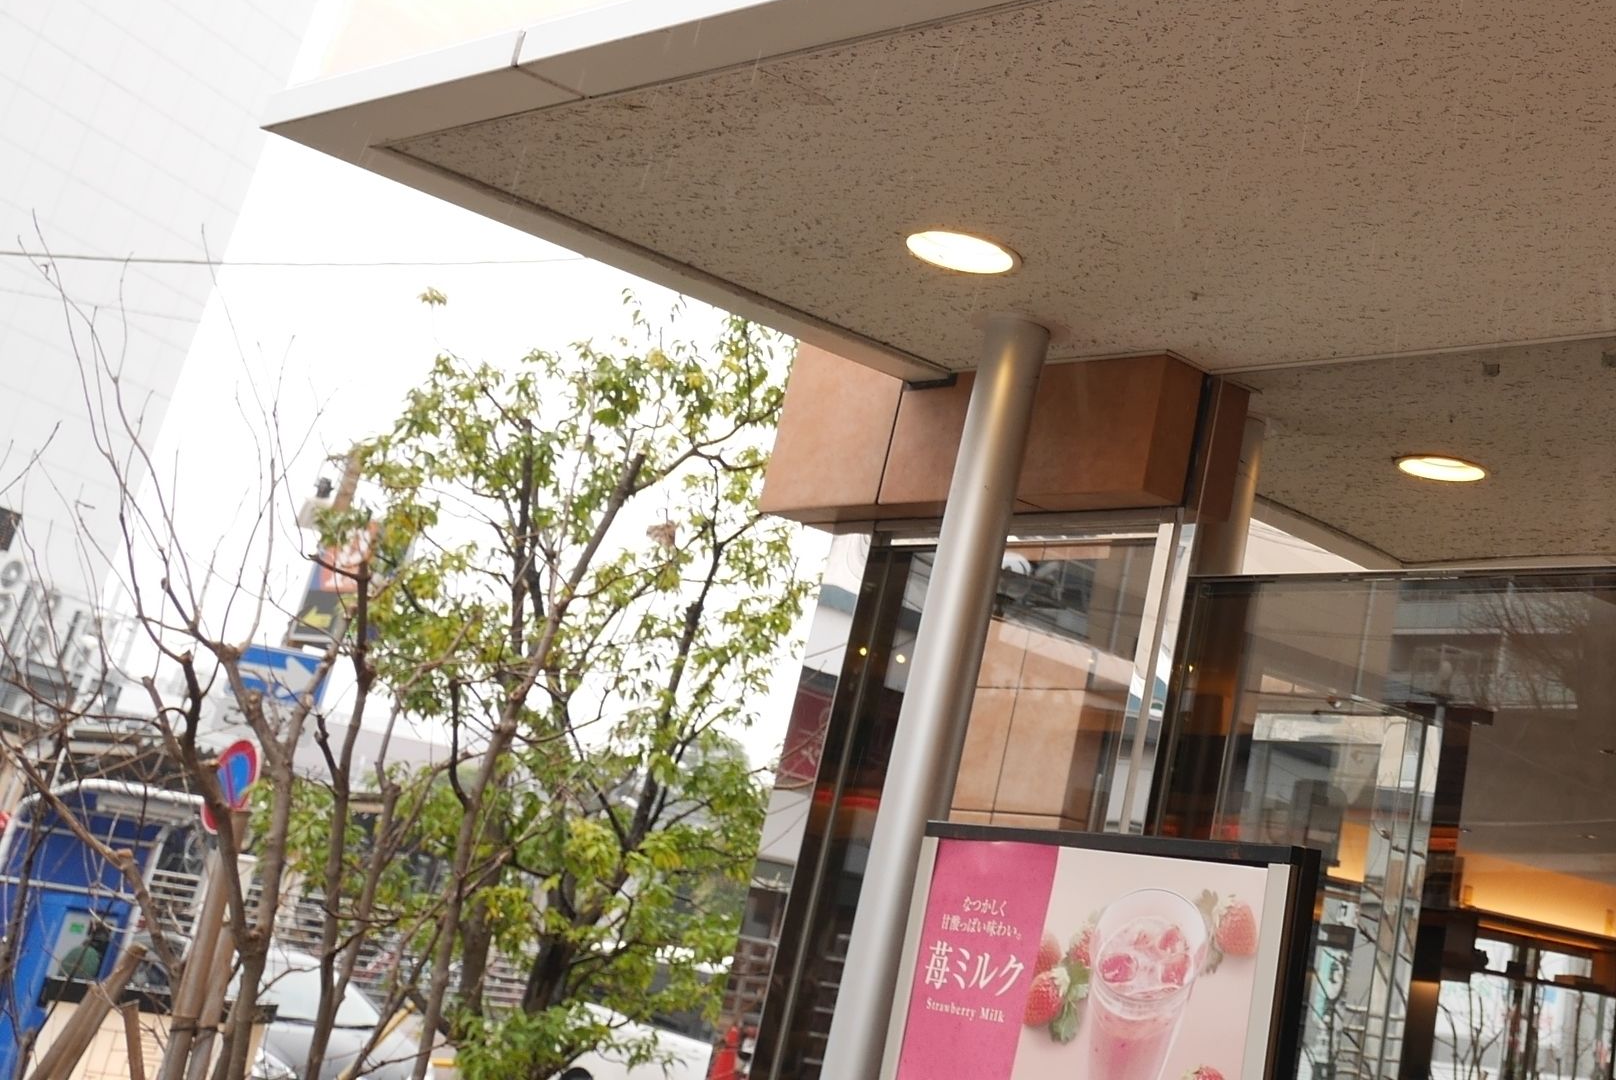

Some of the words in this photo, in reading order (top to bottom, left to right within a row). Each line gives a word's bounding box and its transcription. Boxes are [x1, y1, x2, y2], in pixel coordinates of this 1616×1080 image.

[962, 896, 1008, 916] なつかしく
[925, 940, 1025, 997] 苺ミルク
[925, 997, 977, 1021] Strawberry
[979, 1007, 1006, 1023] Milk
